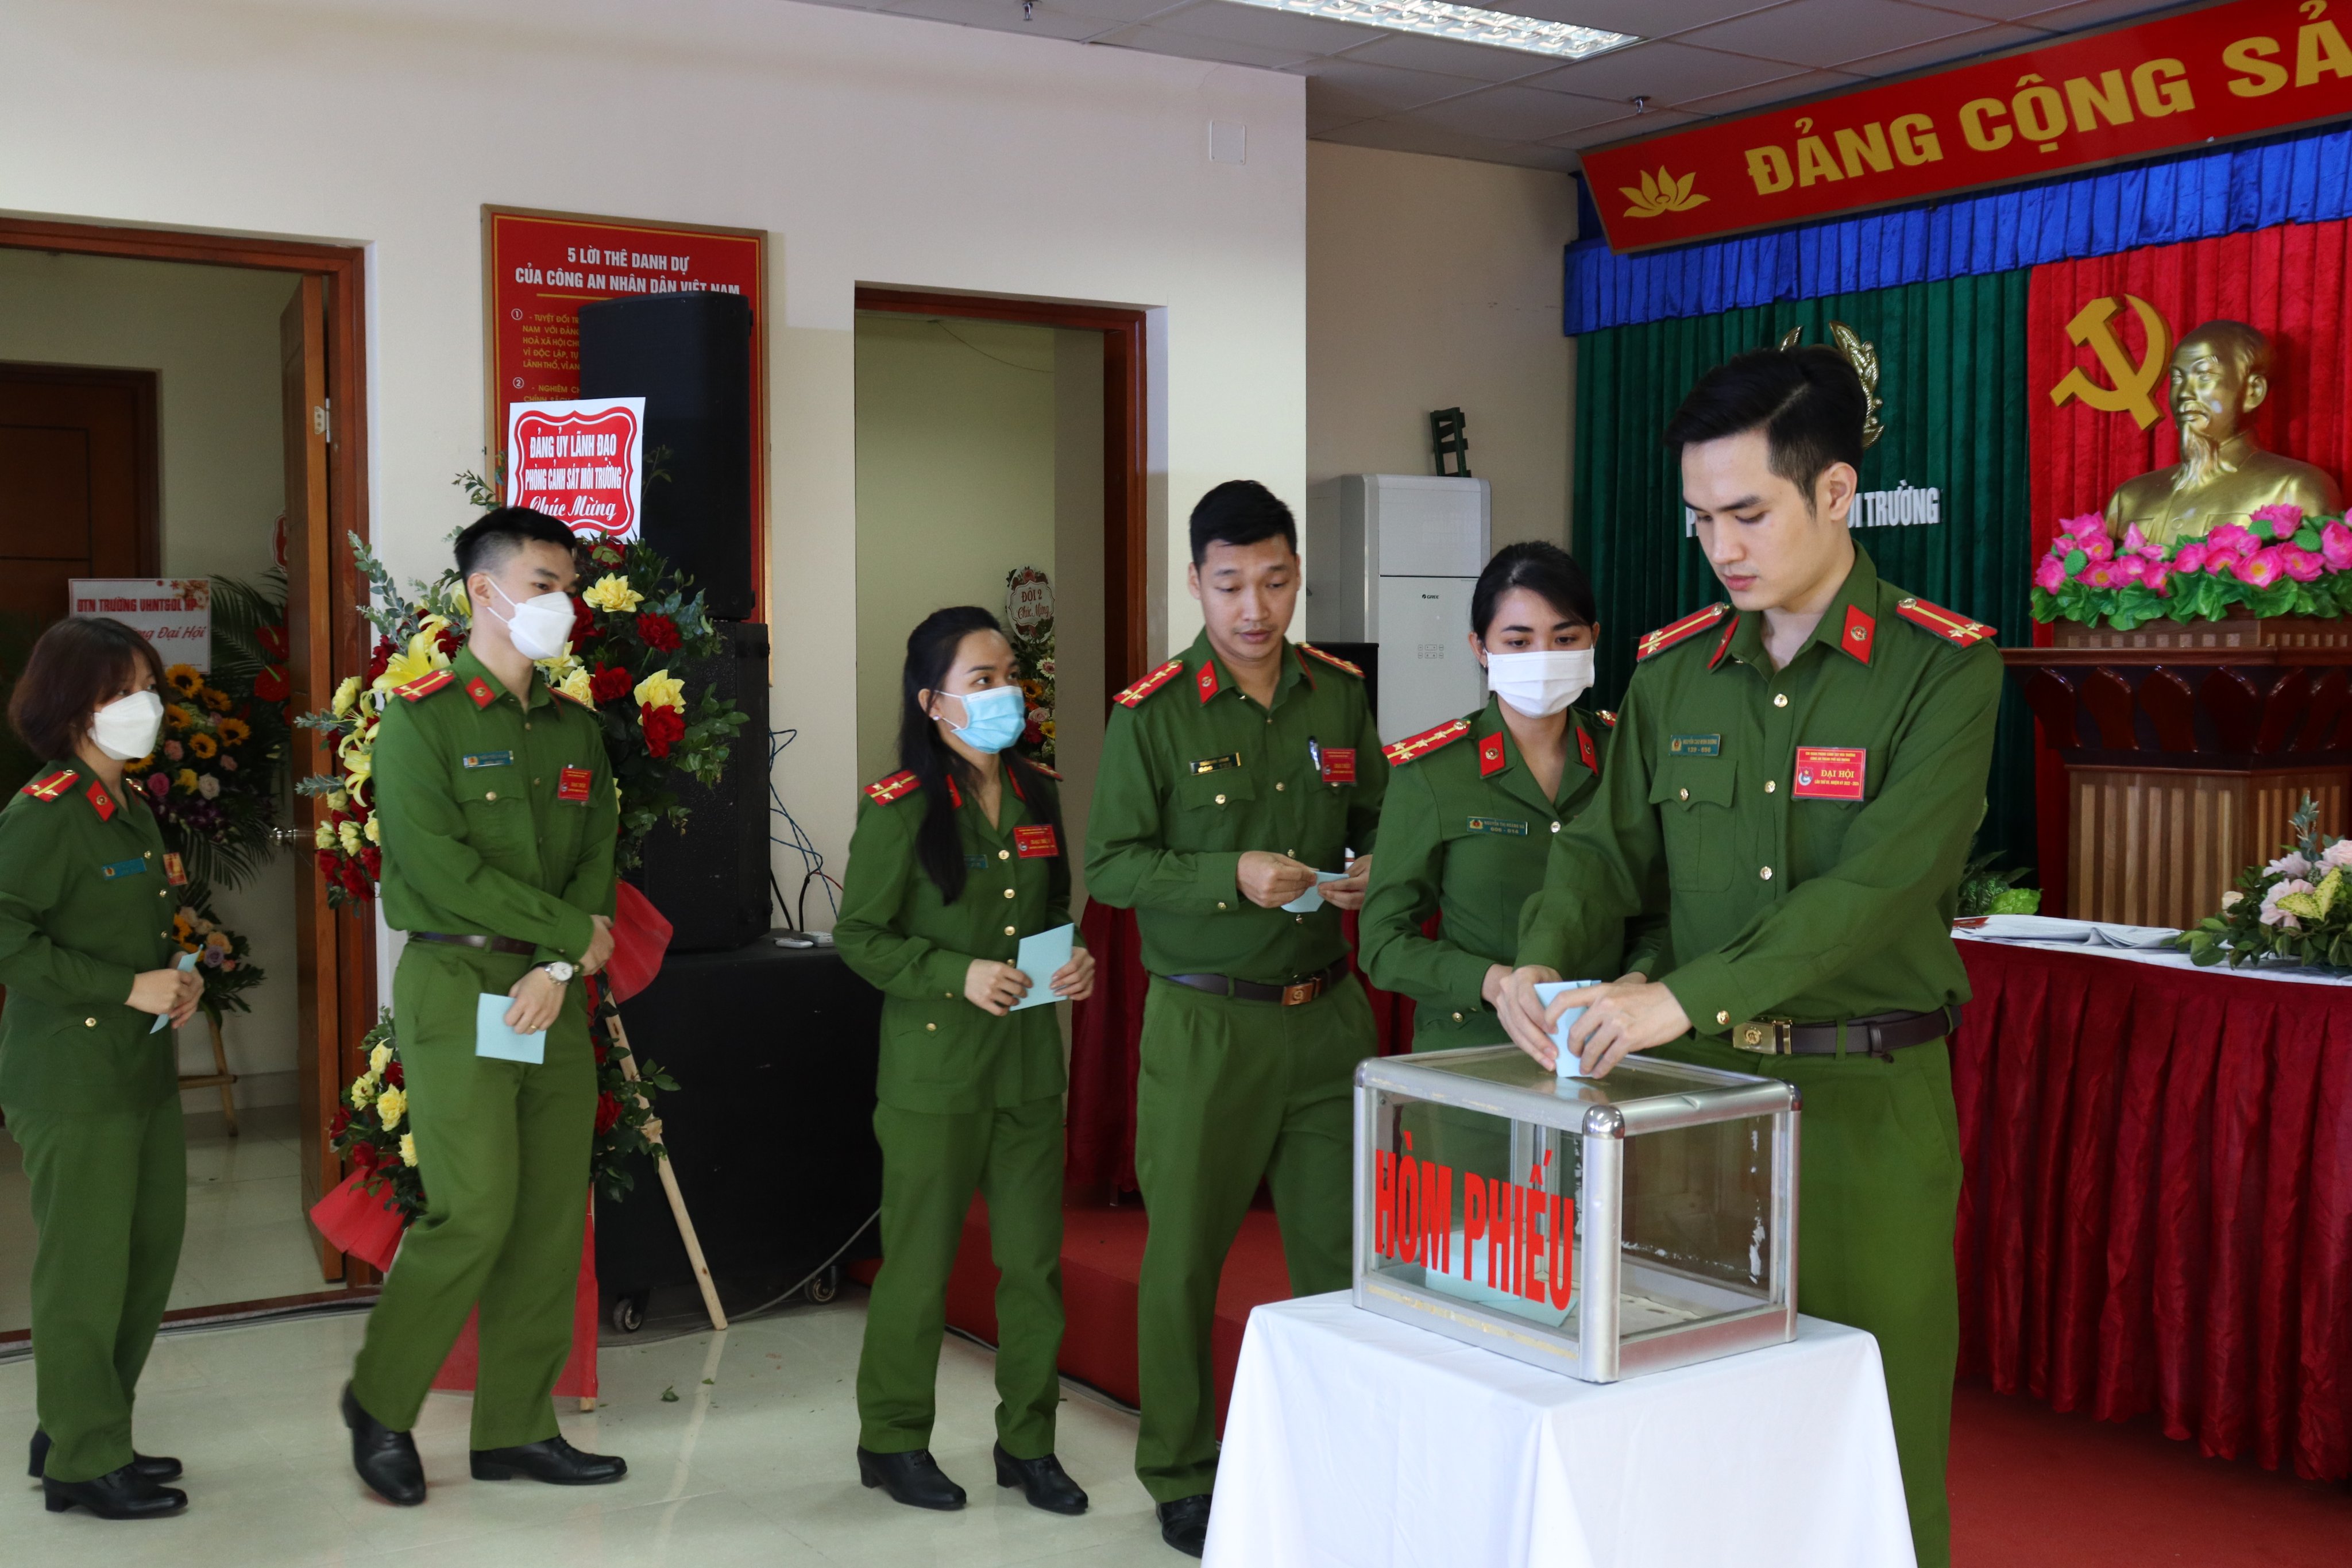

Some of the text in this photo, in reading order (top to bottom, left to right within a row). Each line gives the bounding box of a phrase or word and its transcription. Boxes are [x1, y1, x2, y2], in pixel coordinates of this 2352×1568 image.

[1745, 113, 1944, 196] ĐẢNG
[1959, 57, 2196, 154] CỘNG
[567, 247, 576, 262] 5
[580, 245, 600, 264] LỜI
[632, 253, 667, 270] DANH
[671, 256, 689, 275] DỰ
[515, 262, 543, 284] CỦA
[547, 268, 583, 287] CÔNG
[587, 274, 605, 289] AN
[609, 273, 646, 292] NHÂN
[650, 275, 677, 293] DÂN
[710, 283, 740, 295] NAM
[534, 313, 554, 323] TUYỆT
[544, 325, 558, 333] VỚI
[540, 337, 551, 345] XÃ
[552, 338, 565, 347] HỘI
[523, 347, 531, 356] VÌ
[534, 348, 550, 358] ĐỘC
[523, 359, 542, 368] LÃNH
[561, 361, 569, 370] VÌ
[538, 384, 567, 393] NGHIÊM
[530, 426, 617, 461] ĐẢNG ỦY LÃNH ĐẠO
[525, 459, 621, 491] PHÒNG CẢNH SÁT MÔI TRƯỜNG
[529, 495, 616, 521] Chúc Mừng
[1864, 479, 1940, 527] TRƯỜNG
[1021, 587, 1042, 605] ĐỘI 2
[1018, 605, 1032, 619] Chúc
[157, 627, 181, 640] Đại
[181, 625, 206, 640] Hội
[1821, 768, 1854, 779] ĐẠI HỘI
[1375, 1130, 1574, 1311] HÒM PHIẾU
